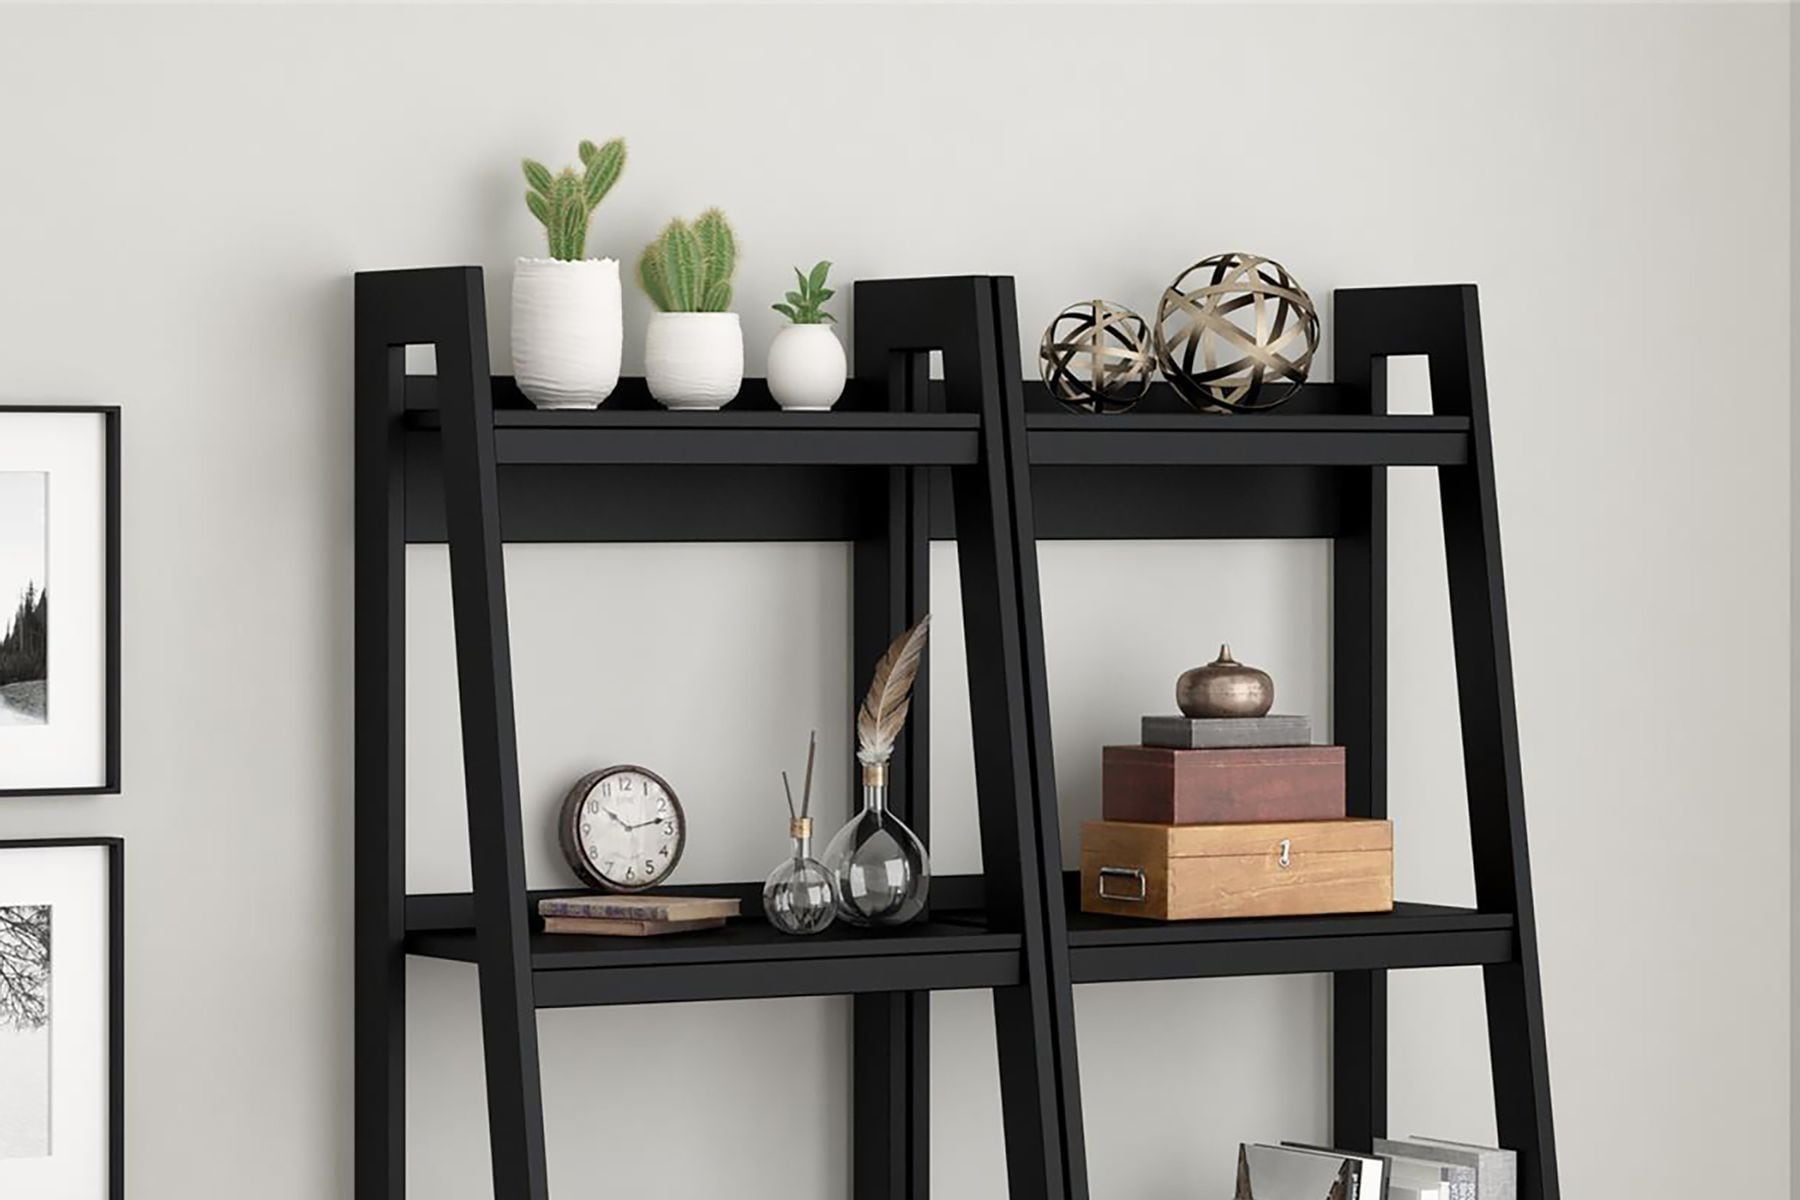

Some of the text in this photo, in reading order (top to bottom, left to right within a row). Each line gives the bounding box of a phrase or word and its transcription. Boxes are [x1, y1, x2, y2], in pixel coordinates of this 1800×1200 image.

[602, 782, 611, 797] 11
[619, 777, 632, 791] 12
[643, 781, 648, 796] 1
[587, 800, 599, 814] 10
[656, 798, 667, 812] 2
[582, 823, 591, 836] 9
[663, 822, 674, 836] 3
[589, 846, 599, 860] 8
[659, 844, 669, 858] 4
[604, 861, 615, 875] 7
[626, 866, 636, 880] 6
[645, 860, 655, 874] 5
